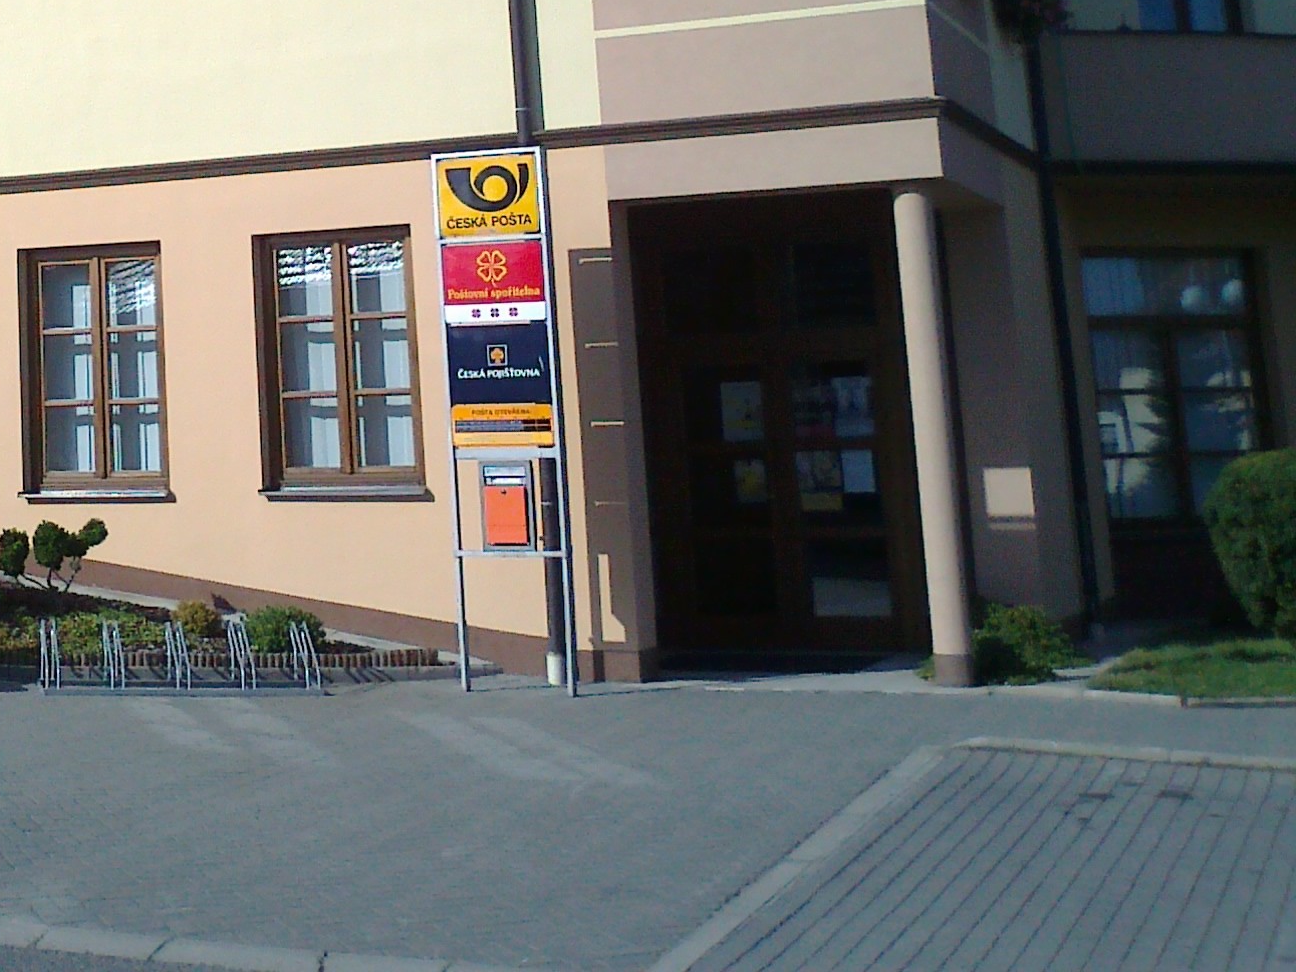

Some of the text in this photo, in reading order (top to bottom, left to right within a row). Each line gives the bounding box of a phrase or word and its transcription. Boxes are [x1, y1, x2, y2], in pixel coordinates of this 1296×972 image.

[446, 212, 532, 230] ČESKÁ POŠTA
[447, 285, 541, 300] Poštovní spořitelna
[457, 366, 541, 379] ČESKÁ POJIŠŤOVNA
